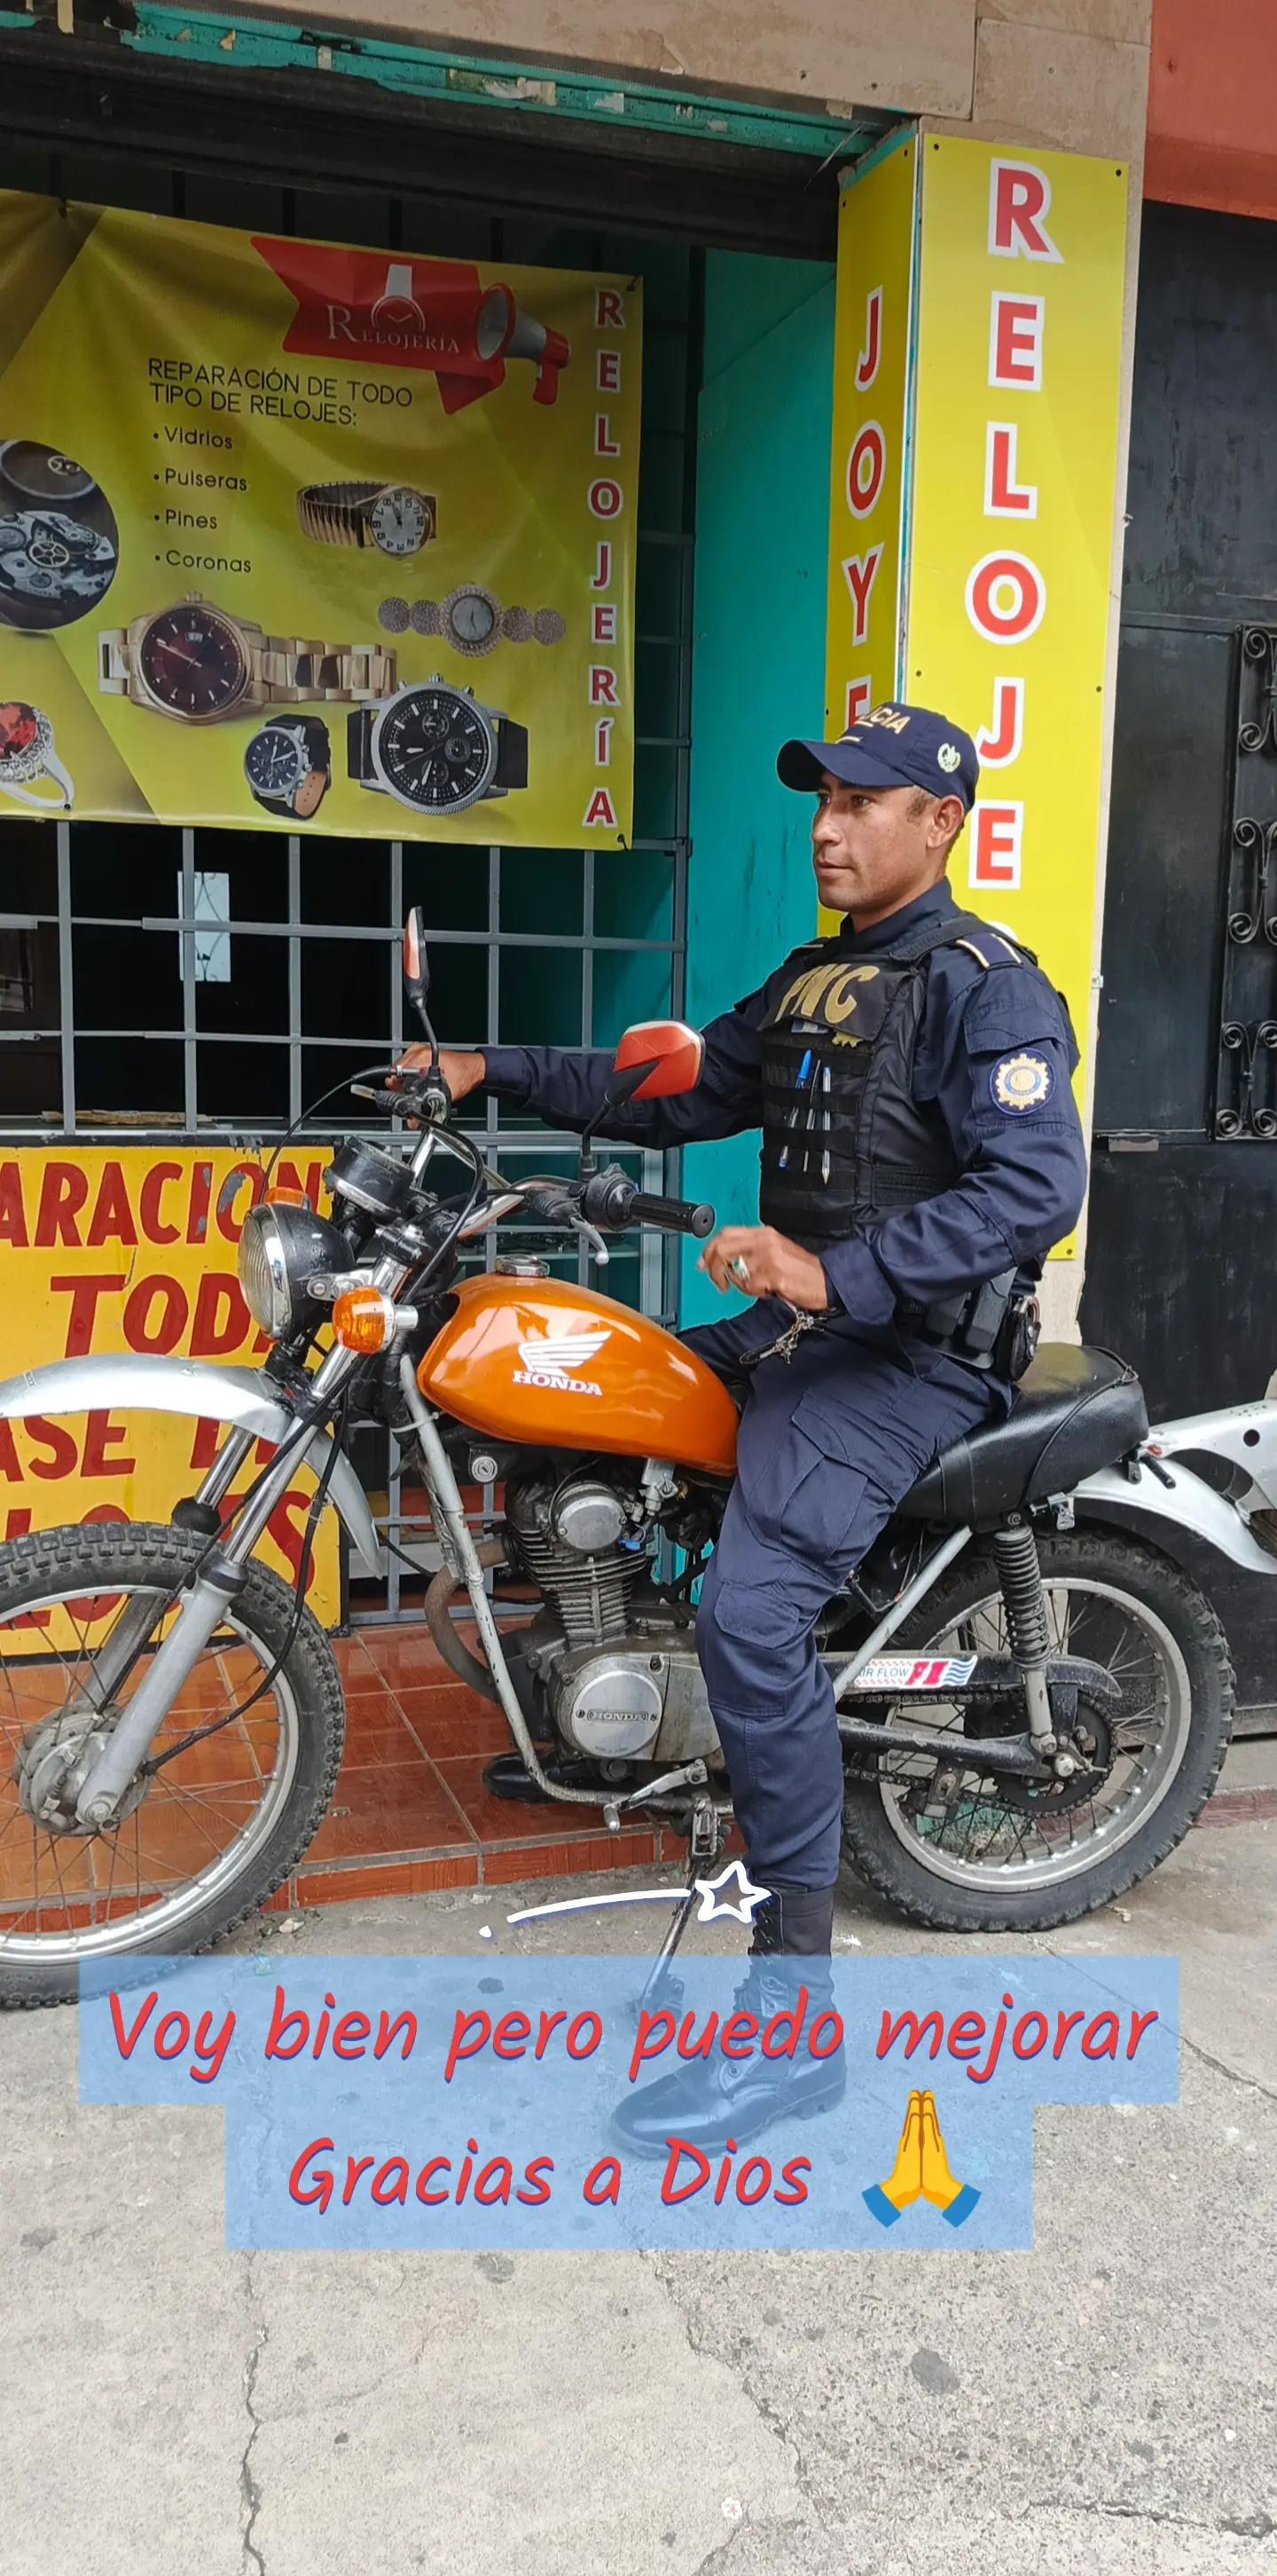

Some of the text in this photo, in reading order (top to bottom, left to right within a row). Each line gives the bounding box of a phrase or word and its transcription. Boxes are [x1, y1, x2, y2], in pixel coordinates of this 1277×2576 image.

[149, 357, 413, 407] REPARACIÓN DE TODO
[150, 382, 357, 427] TIPO DE RELOJES:
[164, 426, 234, 450] Vidrios
[165, 467, 248, 491] Pulseras
[166, 509, 217, 530] Pines
[166, 550, 252, 573] Coronas
[584, 288, 626, 829] RELOJERÍA
[965, 158, 1064, 940] RELOJE
[774, 963, 881, 1025] PNC
[51, 1273, 277, 1355] TOD
[512, 1370, 603, 1396] HONDA
[877, 1668, 909, 1677] FLOW
[591, 1712, 645, 1722] HONDA
